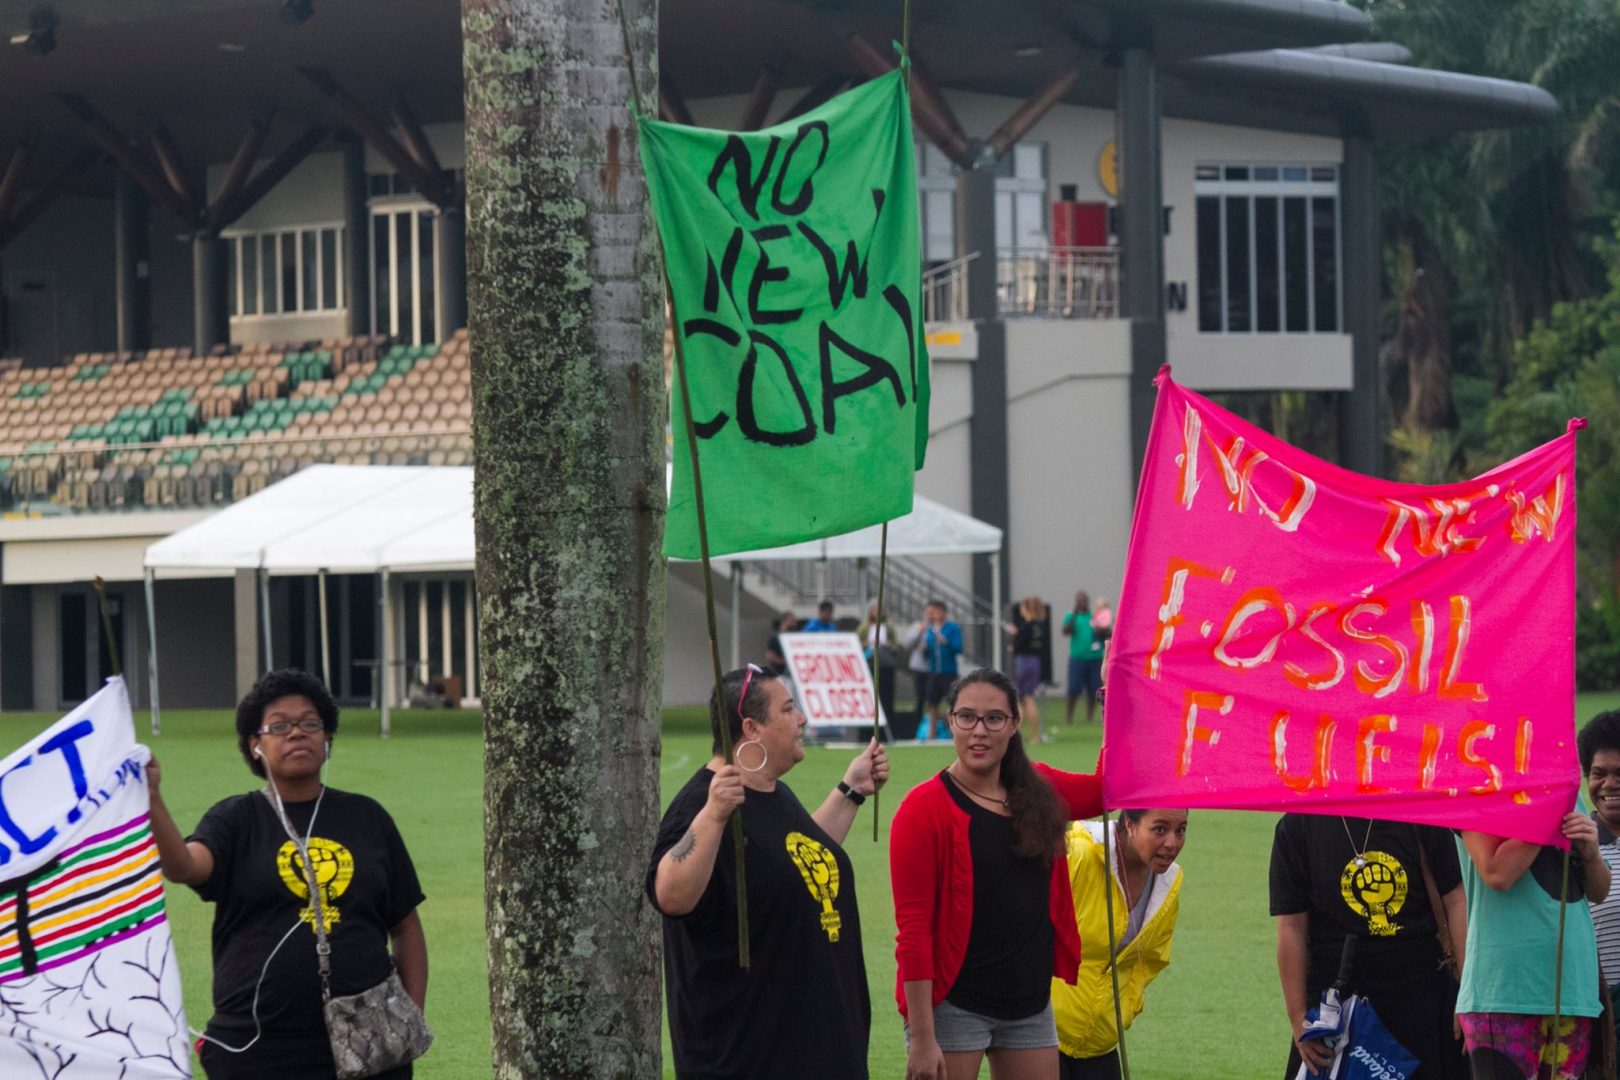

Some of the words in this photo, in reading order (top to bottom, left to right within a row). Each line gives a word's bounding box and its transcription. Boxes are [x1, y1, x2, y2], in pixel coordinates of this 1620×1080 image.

[708, 120, 828, 223] NO
[704, 188, 885, 324] NEW
[1175, 400, 1316, 532] NO
[1376, 472, 1566, 567] NEW
[793, 653, 866, 683] GROUND
[1146, 555, 1489, 701] FOSSIL
[804, 688, 876, 720] CLOSED
[1175, 690, 1532, 805] FUELS!
[0, 719, 94, 867] CT
